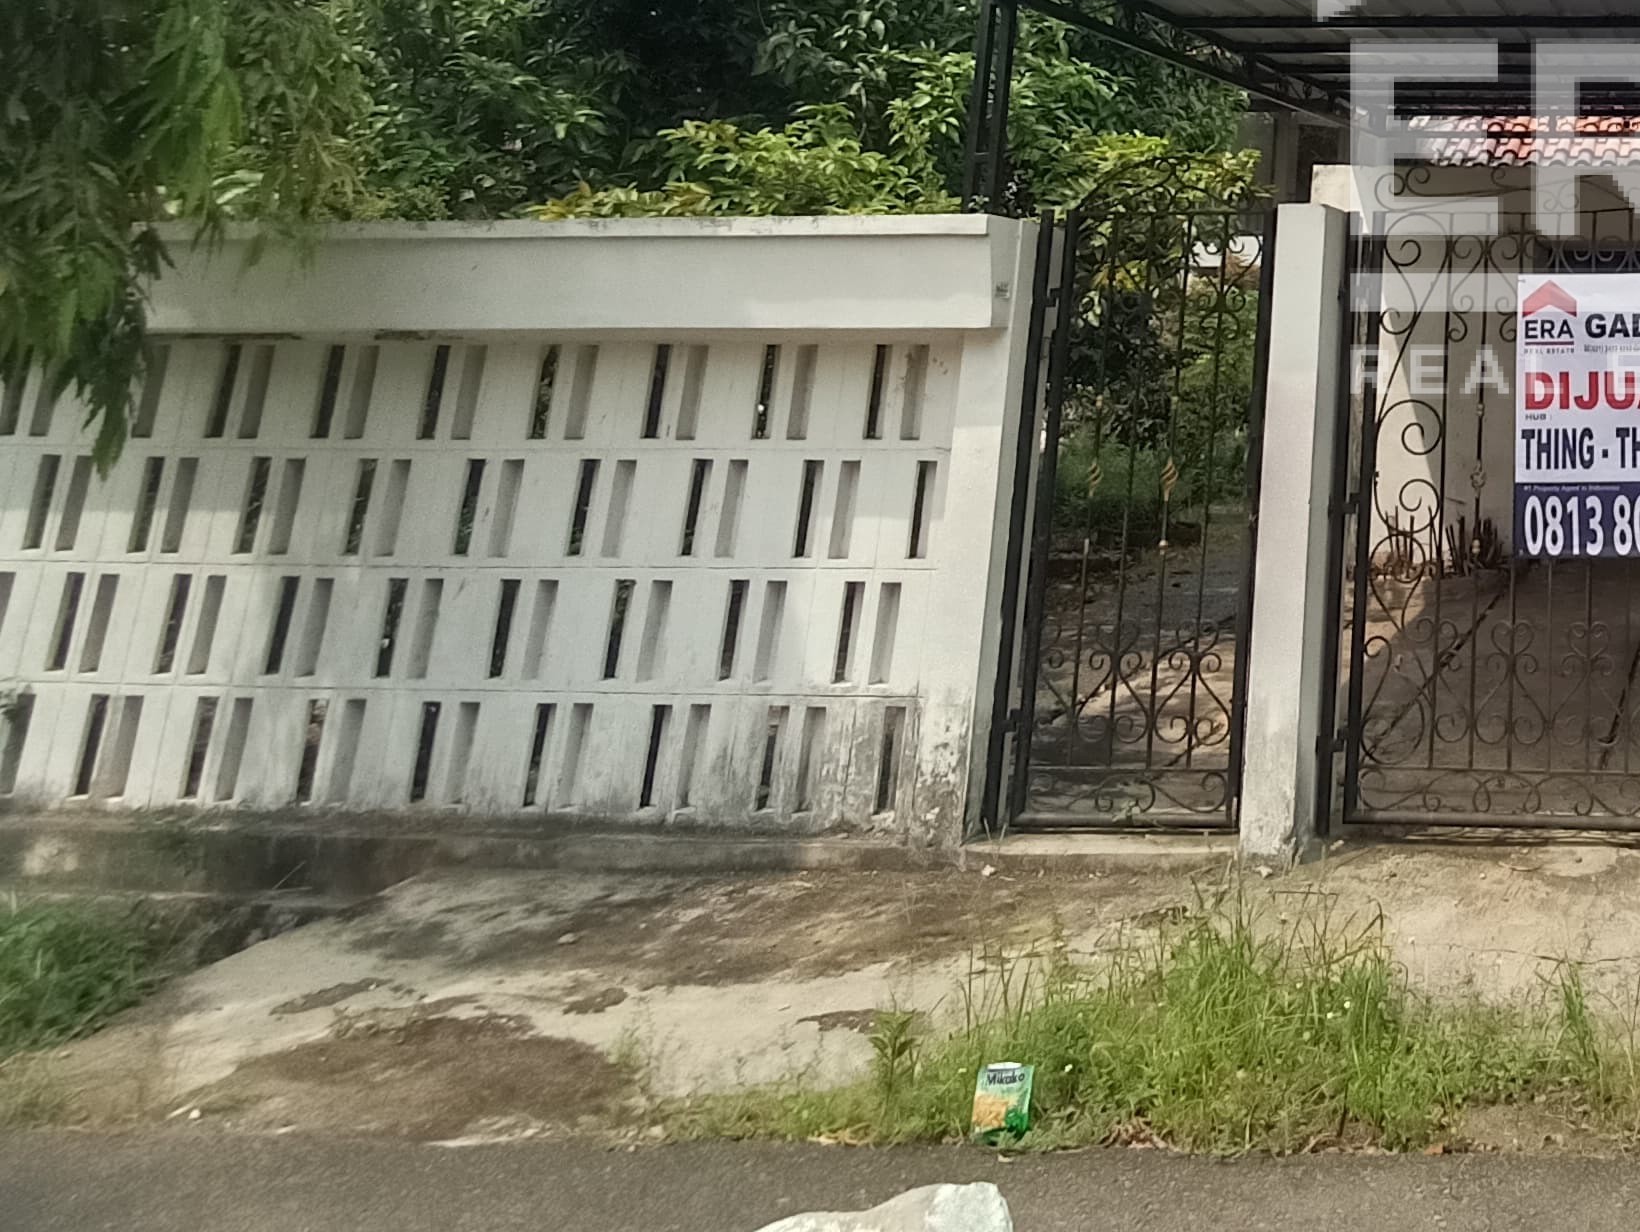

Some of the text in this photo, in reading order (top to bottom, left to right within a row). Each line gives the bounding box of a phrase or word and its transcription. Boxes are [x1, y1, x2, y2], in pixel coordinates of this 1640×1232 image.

[1524, 319, 1575, 339] ERA
[1521, 427, 1595, 469] THING
[1524, 495, 1604, 556] 0813
